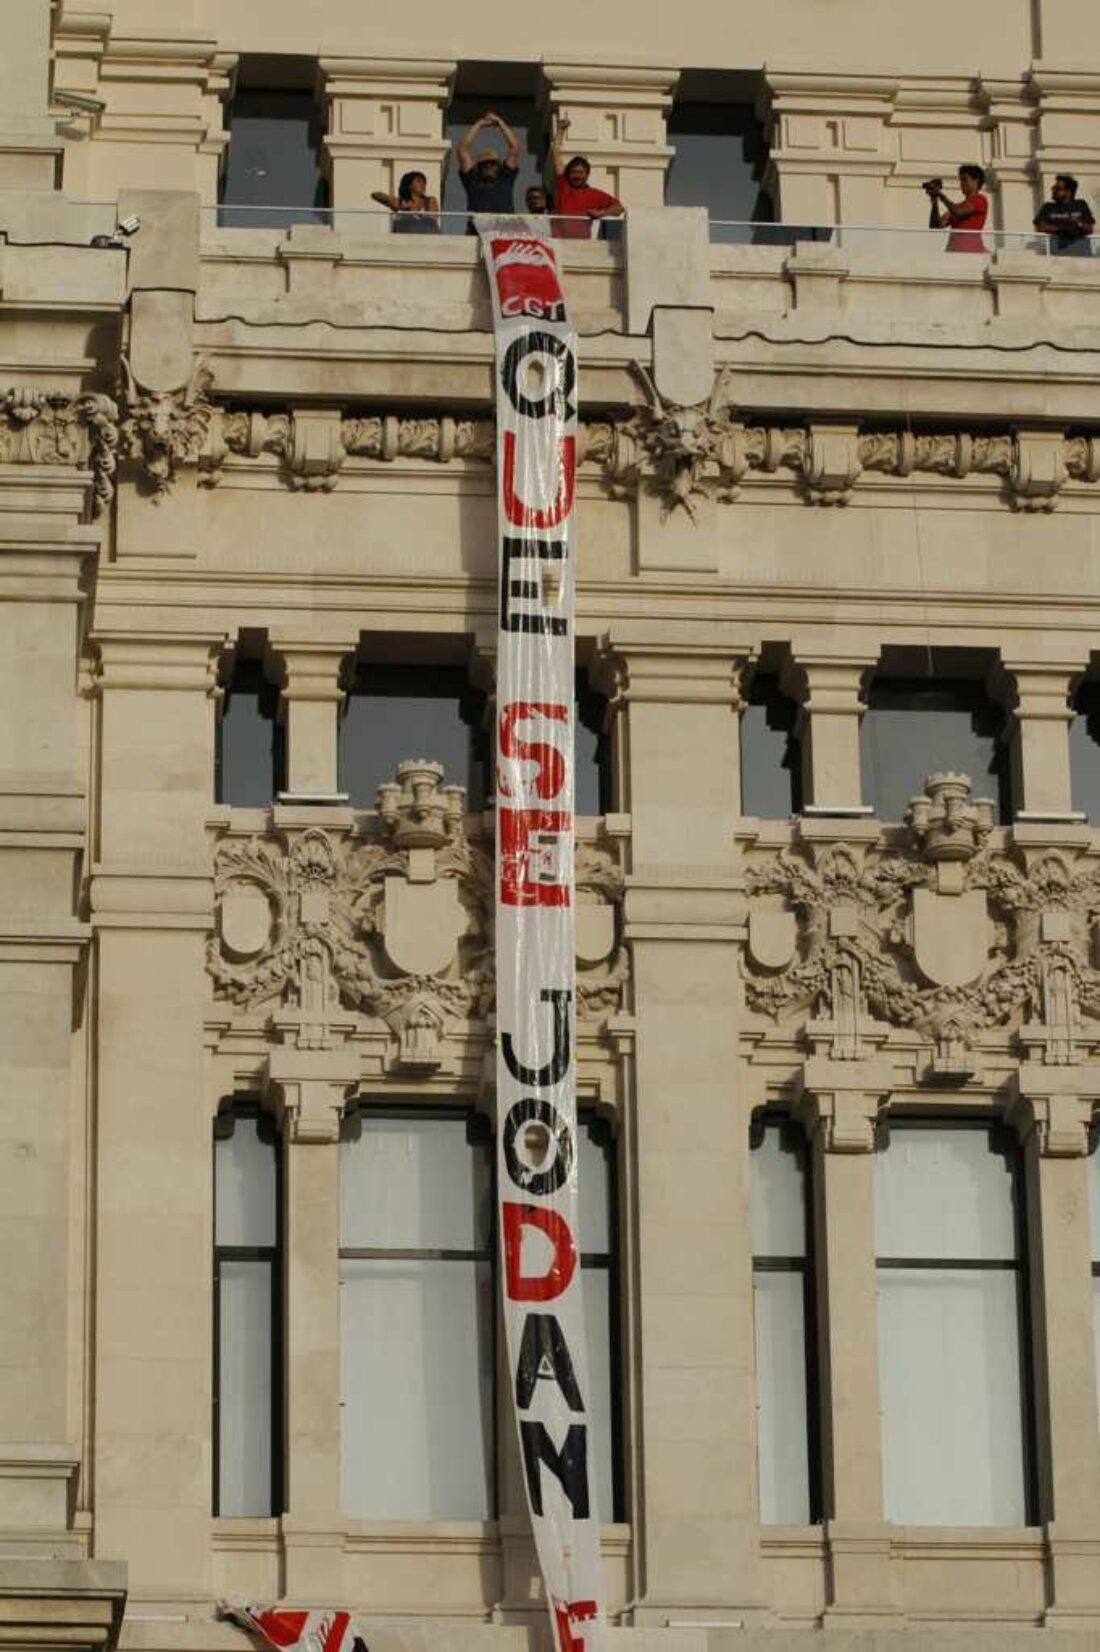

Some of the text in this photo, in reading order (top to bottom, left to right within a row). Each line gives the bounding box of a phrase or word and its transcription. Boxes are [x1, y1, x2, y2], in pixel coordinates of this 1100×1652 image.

[501, 295, 564, 321] CGT
[501, 331, 577, 636] QUE
[496, 701, 571, 908] SE
[501, 989, 590, 1519] JODAN
